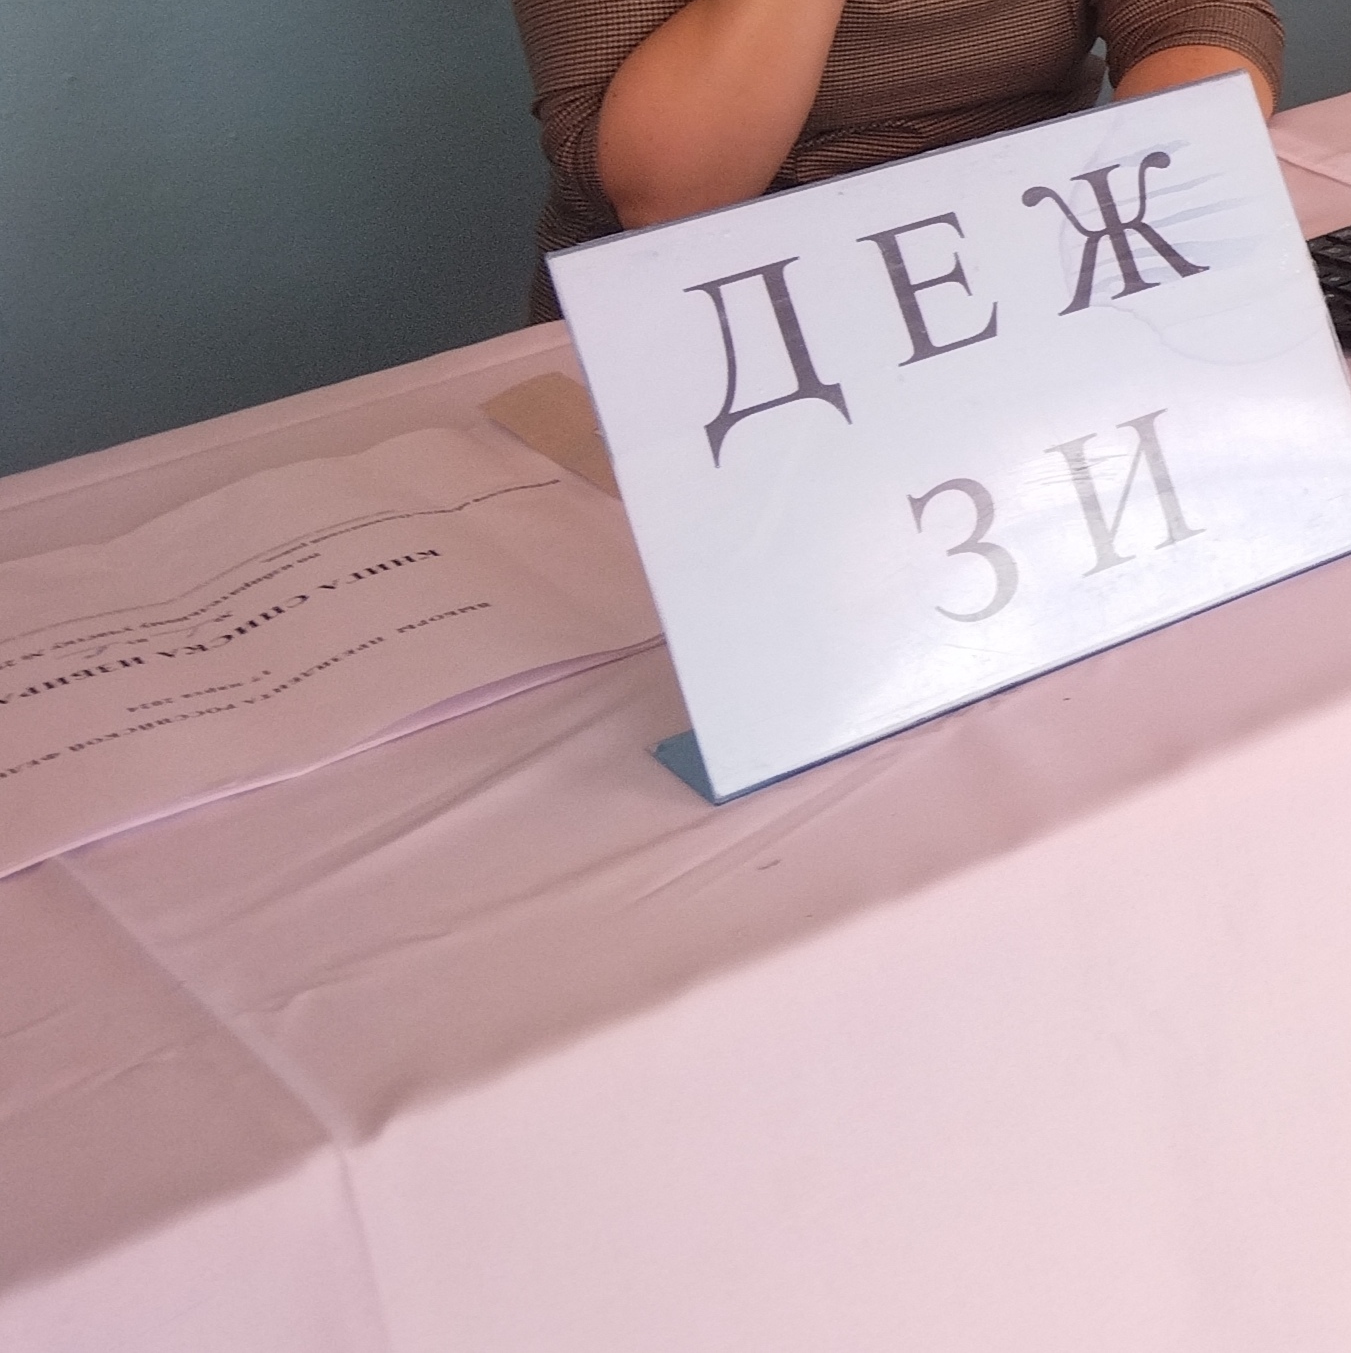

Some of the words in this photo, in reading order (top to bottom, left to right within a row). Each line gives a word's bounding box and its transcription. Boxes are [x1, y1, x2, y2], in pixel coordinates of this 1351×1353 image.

[316, 549, 441, 590] КНИГА
[156, 594, 310, 659] СПИСКА
[396, 602, 492, 634] ВЫБОРЫ
[242, 636, 385, 705] ПРЕЗИДЕНТА
[68, 703, 237, 752] РОССИЙСКОЙ
